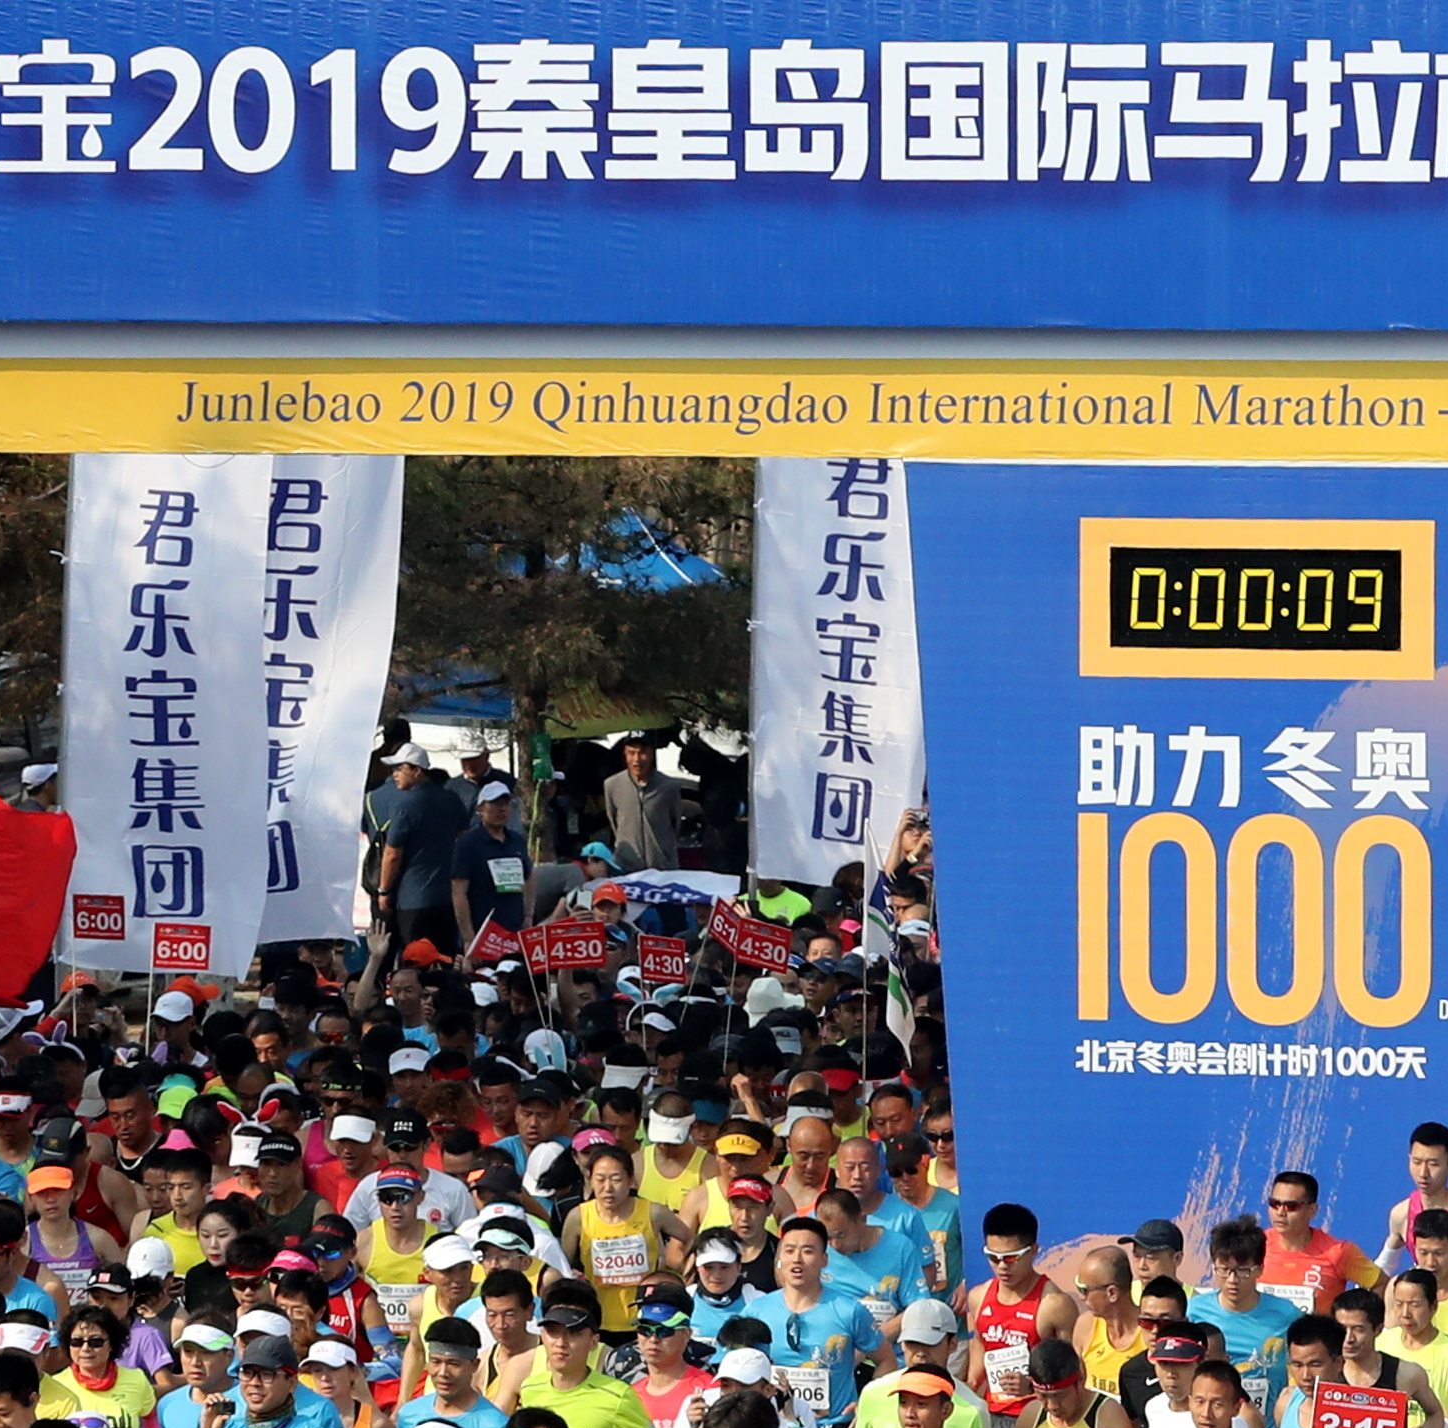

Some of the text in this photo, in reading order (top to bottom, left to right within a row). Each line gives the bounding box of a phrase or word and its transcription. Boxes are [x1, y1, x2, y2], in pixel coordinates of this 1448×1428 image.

[177, 380, 381, 424] Junlebao
[400, 381, 513, 421] 2019
[533, 381, 847, 435] Qinhuangdao
[871, 382, 1171, 425] International
[1129, 567, 1384, 632] 0:00:09
[810, 457, 894, 846] 君乐宝集团
[123, 489, 206, 919] 君乐宝集团
[1077, 725, 1431, 811] 助力冬奥
[75, 911, 122, 932] 6:00
[1077, 812, 1432, 1029] 1000
[157, 939, 207, 961] 6:00
[551, 939, 603, 959] 4:30
[643, 953, 685, 976] 4:30
[739, 937, 787, 964] 4:30
[1074, 1040, 1428, 1080] 北京冬奥会倒计时1000天
[594, 1252, 645, 1270] S2040
